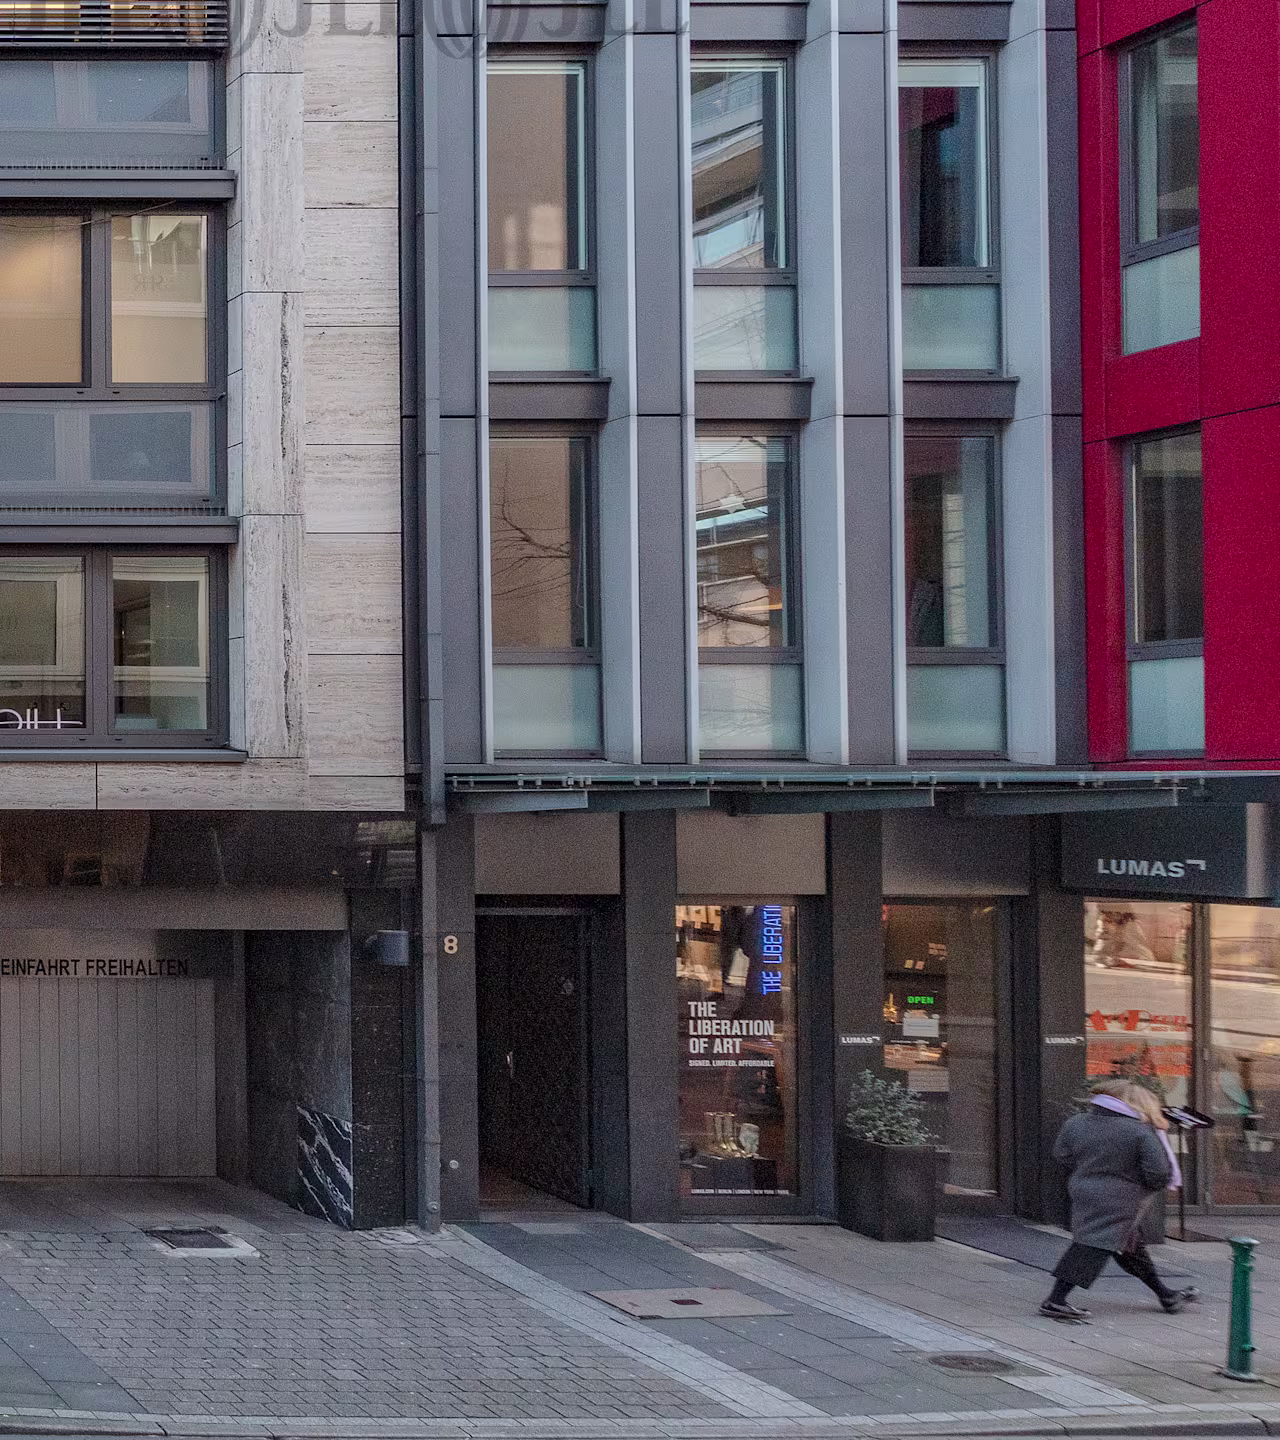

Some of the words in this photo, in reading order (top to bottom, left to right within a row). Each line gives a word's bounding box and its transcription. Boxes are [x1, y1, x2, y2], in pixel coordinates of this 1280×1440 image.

[1097, 858, 1186, 878] LUMAS
[444, 935, 458, 954] 8
[1, 959, 80, 976] EINFAHRT
[86, 959, 188, 976] FREIHALTEN
[762, 971, 782, 995] THE
[907, 996, 934, 1004] OPEN
[688, 1001, 717, 1017] THE
[689, 1020, 774, 1035] LIBERATION
[690, 1038, 708, 1053] OF
[713, 1038, 742, 1054] ART
[842, 1036, 873, 1044] LUMAS
[1046, 1037, 1077, 1045] LUMAS
